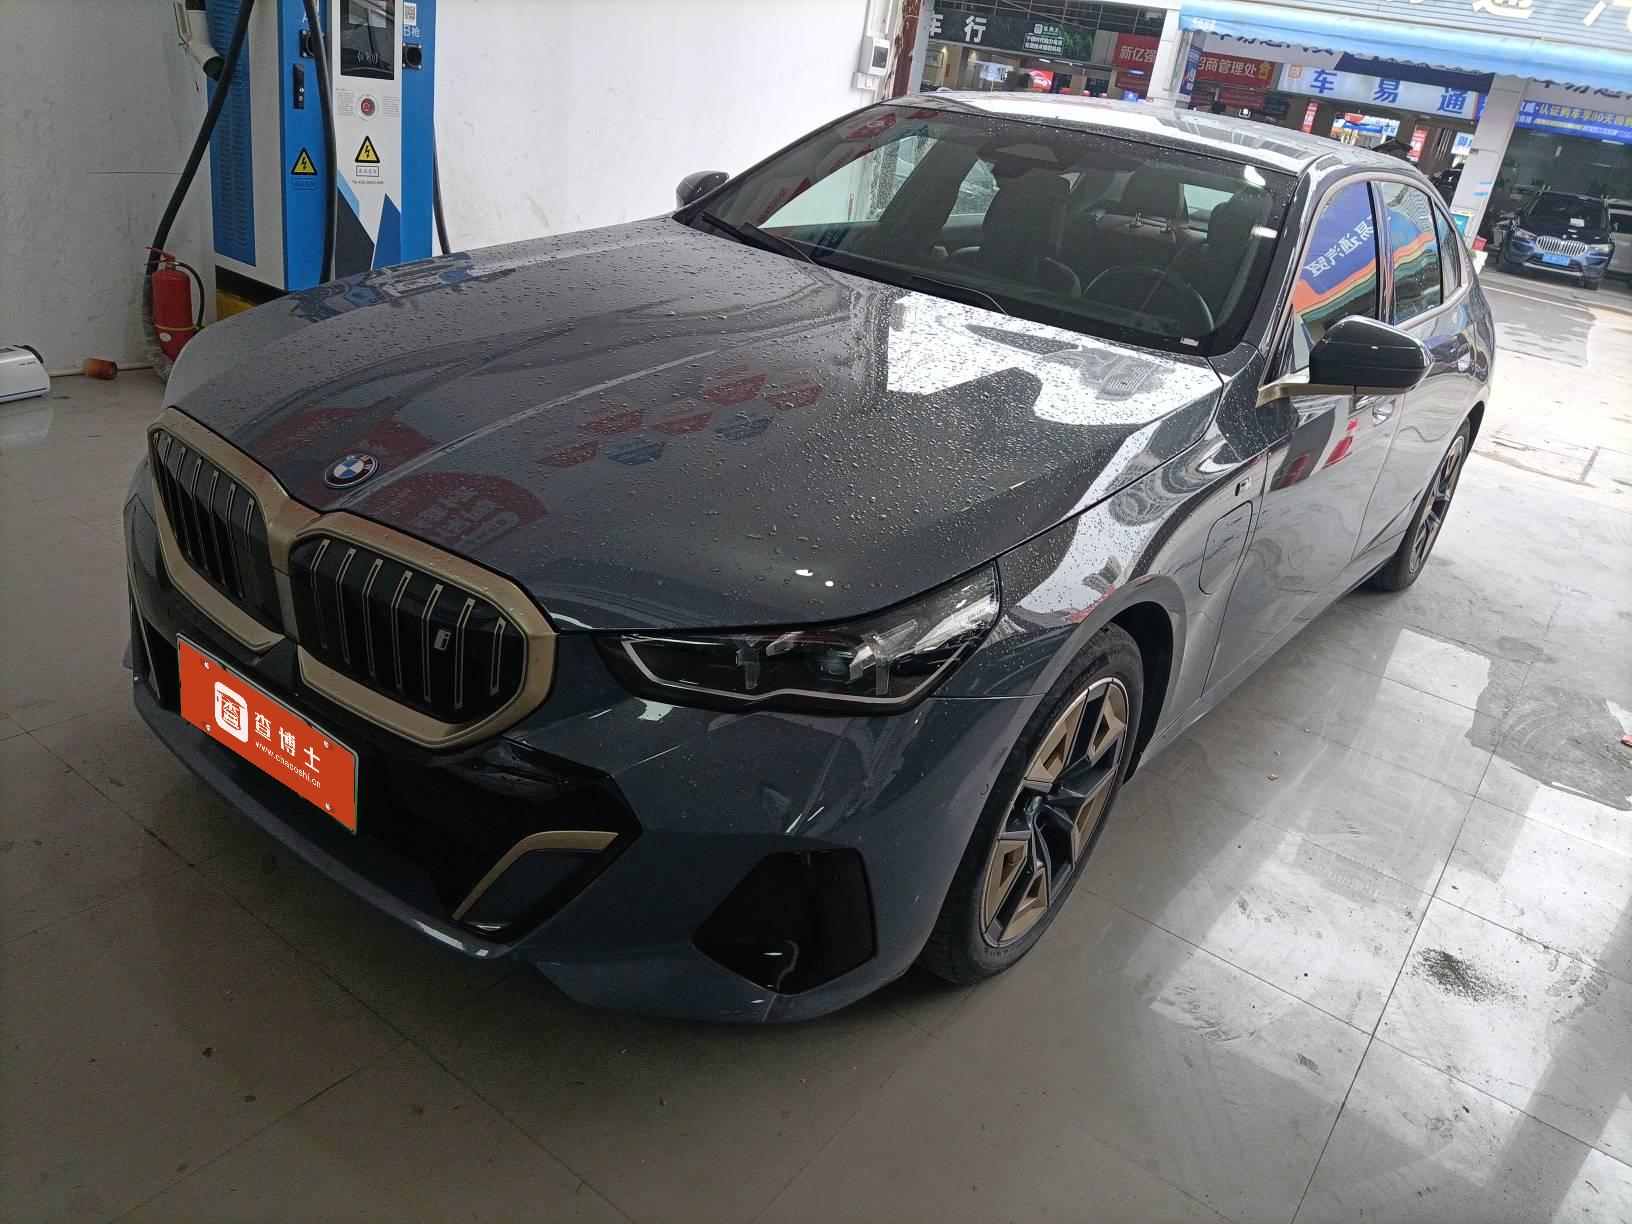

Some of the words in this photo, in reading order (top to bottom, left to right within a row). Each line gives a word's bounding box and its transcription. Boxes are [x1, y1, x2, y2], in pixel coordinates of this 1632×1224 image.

[929, 11, 988, 43] 车行
[1309, 68, 1468, 115] 车易通
